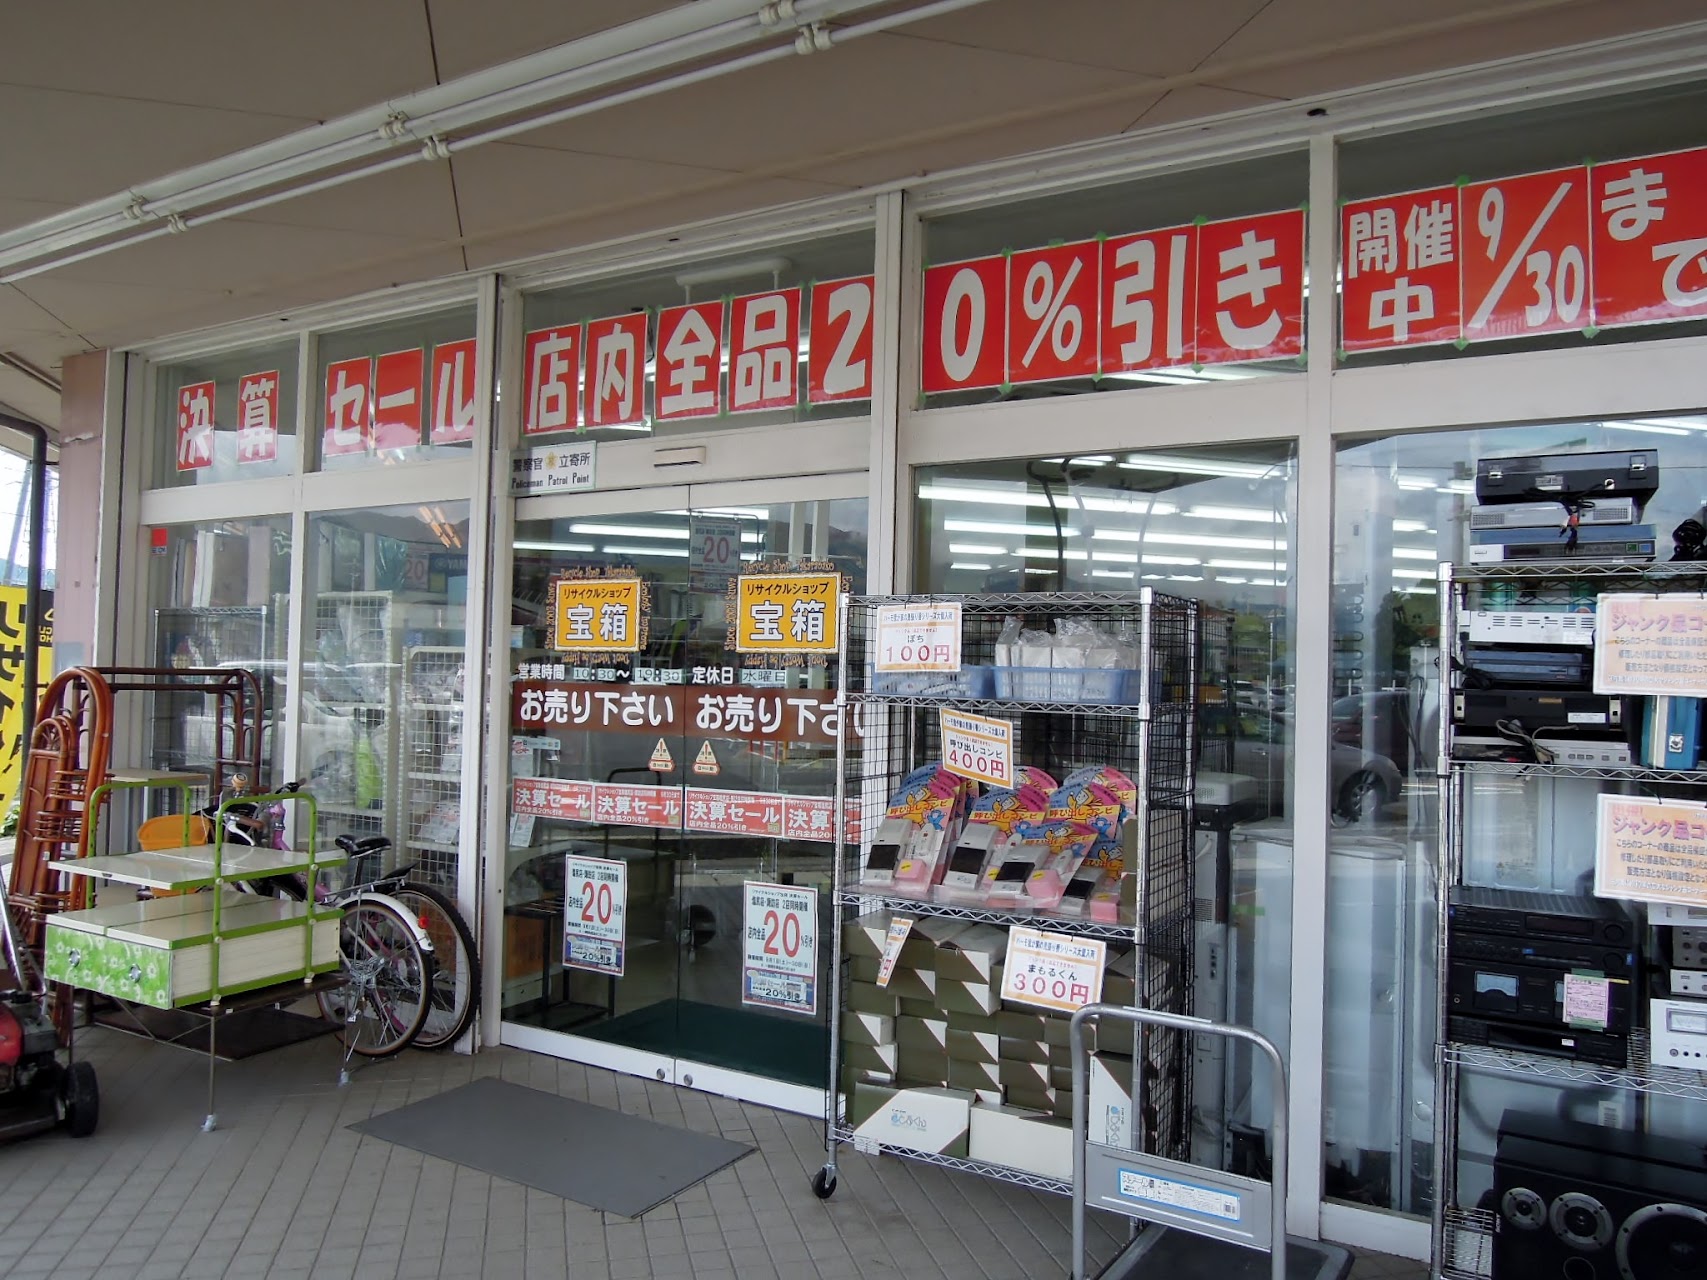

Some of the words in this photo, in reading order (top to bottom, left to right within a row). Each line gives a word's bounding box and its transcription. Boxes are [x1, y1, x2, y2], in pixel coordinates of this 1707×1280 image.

[513, 457, 543, 473] 警察官
[558, 452, 590, 468] 立寄所
[512, 477, 543, 489] Policeman
[548, 475, 568, 486] Patrol
[573, 472, 589, 484] Point
[564, 586, 631, 599] リサイクルショップ
[747, 581, 829, 595] リサイクルショップ
[565, 603, 629, 641] 宝箱
[749, 599, 826, 642] 宝箱
[1612, 613, 1707, 633] ジャンク品コ
[886, 645, 950, 662] 100円
[518, 662, 565, 680] 営業時間
[692, 666, 734, 685] 定休日
[742, 671, 786, 683] 水曜日
[520, 688, 674, 727] お売り下さい
[950, 739, 1003, 759] 呼び出しコンビ
[949, 750, 1004, 779] 400円
[516, 787, 590, 809] 決算セール
[597, 795, 680, 817] 決算セール
[689, 800, 780, 825] 決算セール
[582, 881, 612, 925] 20
[763, 910, 801, 958] 20
[1028, 964, 1078, 981] まもるくん
[1013, 973, 1089, 1004] 300円
